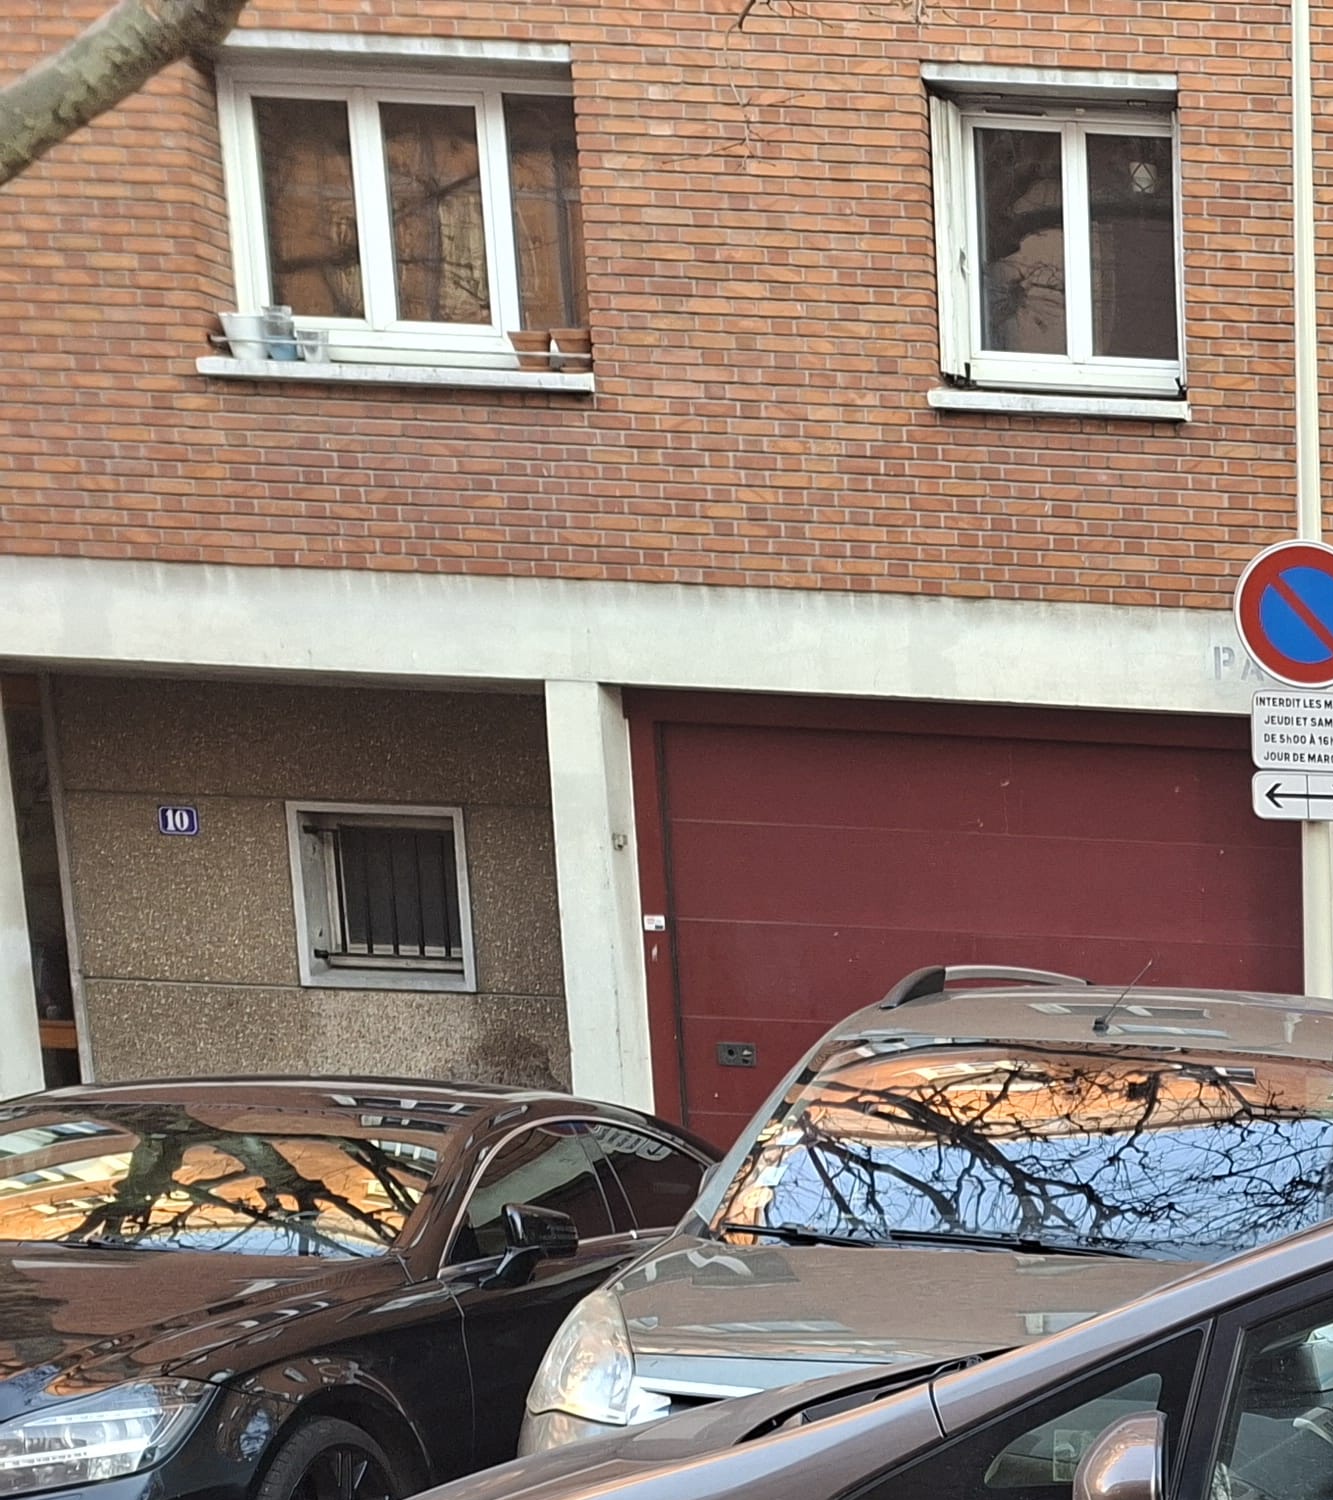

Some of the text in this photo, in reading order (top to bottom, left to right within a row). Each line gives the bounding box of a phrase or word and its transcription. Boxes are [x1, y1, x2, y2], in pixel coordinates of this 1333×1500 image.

[1255, 695, 1301, 708] INTERDIT
[1303, 699, 1322, 709] LES
[1264, 715, 1294, 726] JEUDI
[1295, 716, 1308, 727] ET
[1264, 733, 1278, 743] DE
[1279, 734, 1307, 745] 5h00
[1309, 732, 1316, 745] À
[1263, 751, 1291, 762] JOUR
[1292, 752, 1305, 763] DE
[166, 808, 189, 831] 10
